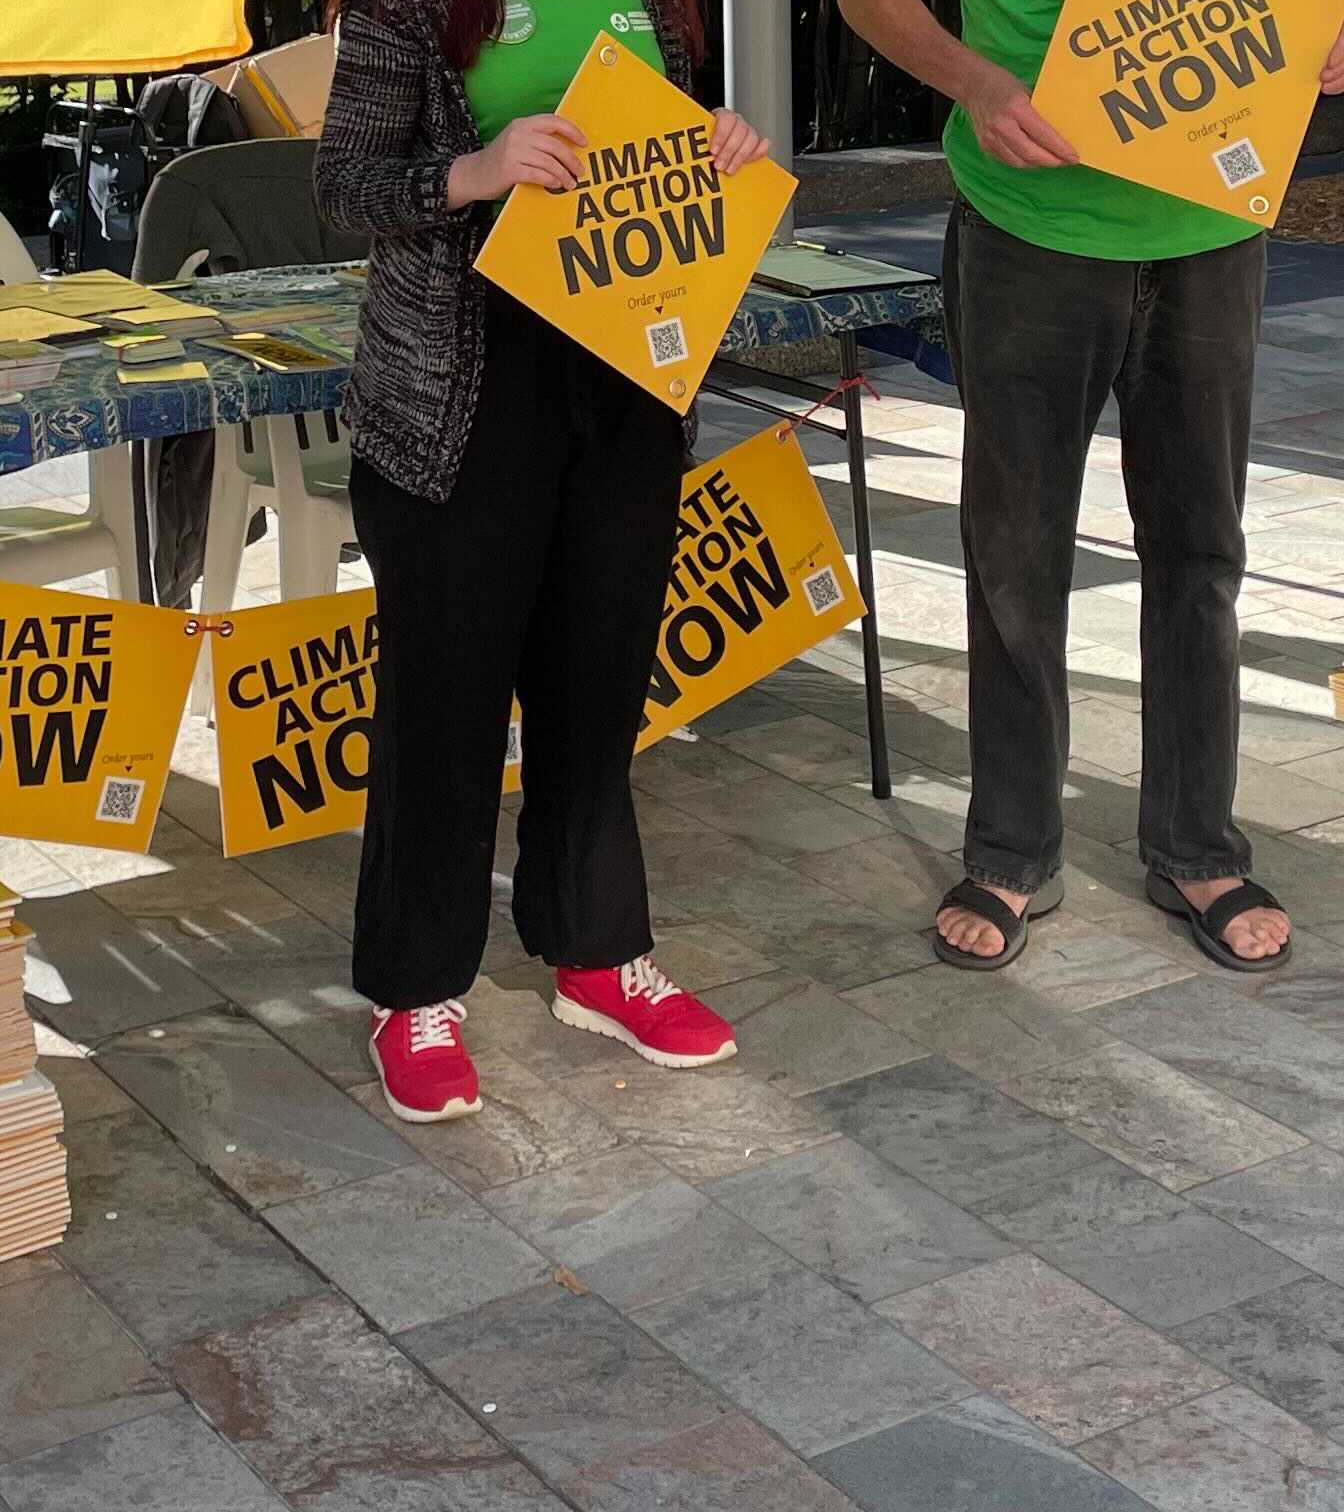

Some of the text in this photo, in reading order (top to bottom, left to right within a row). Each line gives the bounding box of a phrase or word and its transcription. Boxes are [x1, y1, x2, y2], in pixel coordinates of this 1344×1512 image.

[1099, 16, 1287, 145] NOW
[1187, 107, 1252, 142] Order yours
[575, 161, 721, 228] ACTION
[557, 196, 725, 295] NOW
[627, 285, 687, 310] Order yours
[251, 717, 374, 831] NO
